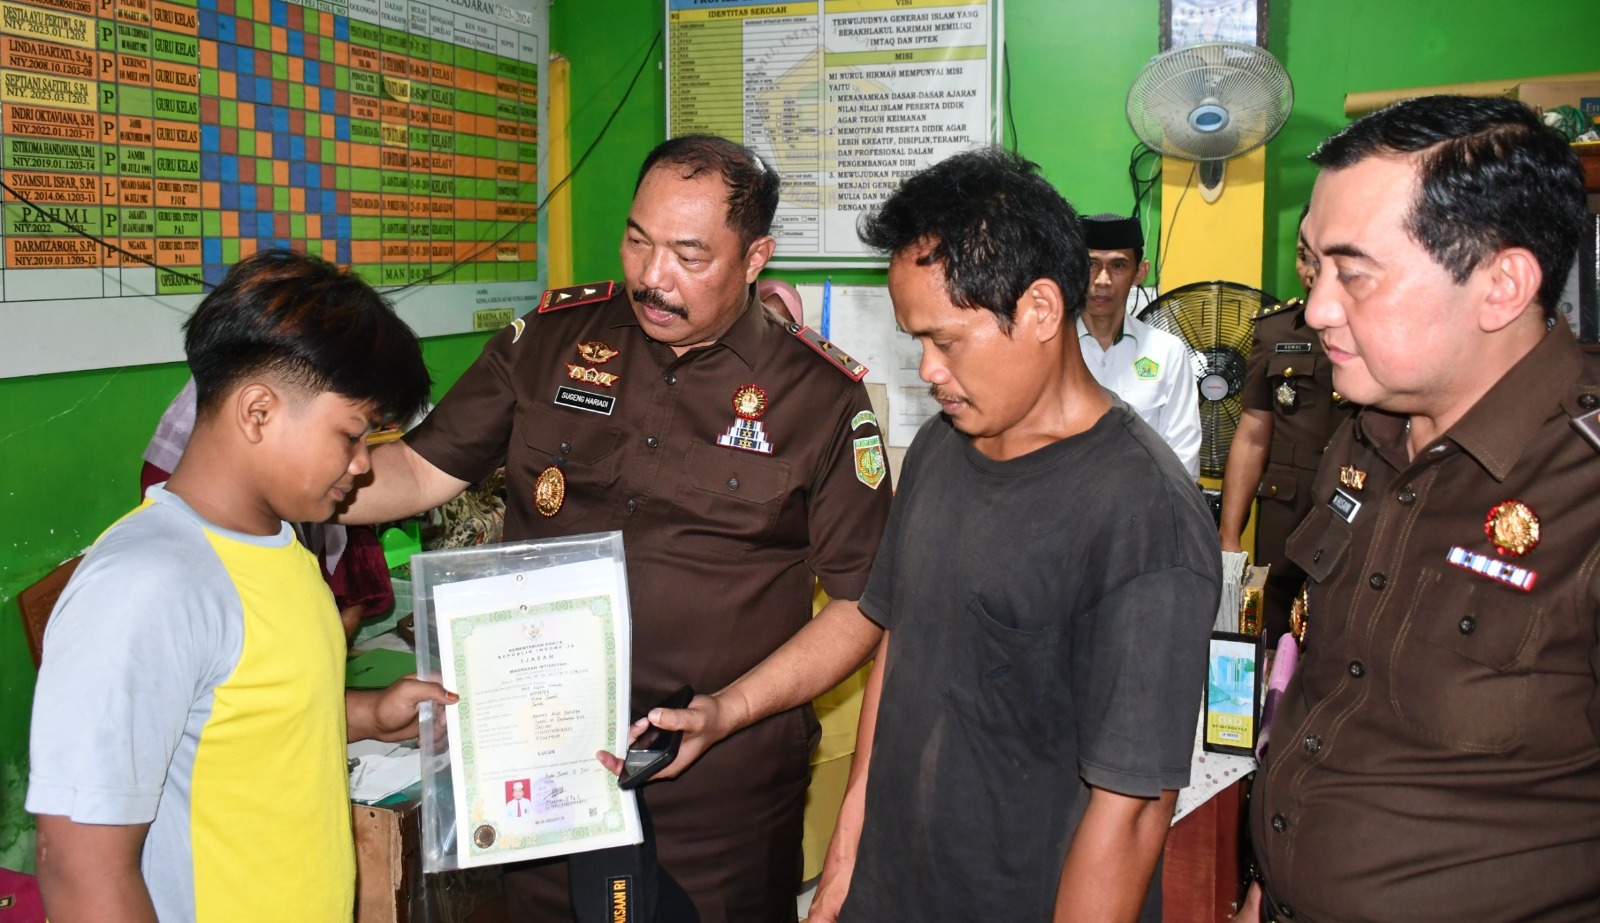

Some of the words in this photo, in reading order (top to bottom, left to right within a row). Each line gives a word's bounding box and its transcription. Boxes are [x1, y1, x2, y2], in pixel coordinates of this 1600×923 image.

[320, 3, 331, 11] TGL
[708, 8, 748, 18] IDENTITAS
[751, 7, 786, 15] SEKOLAH
[3, 6, 28, 21] DESTIA
[30, 11, 43, 25] AYU
[154, 8, 173, 24] GURU
[175, 12, 195, 28] KELAS
[833, 16, 888, 26] TERWUJUDNYA
[890, 14, 929, 22] GENERASI
[931, 12, 955, 21] ISLAM
[957, 10, 978, 19] YANG
[4, 19, 25, 30] NIY.
[28, 23, 88, 42] 2023.01.1203.
[102, 27, 112, 41] P
[839, 27, 893, 37] BERAKHLAKUL
[896, 25, 932, 34] KARIMAH
[935, 23, 972, 32] MEMILIKI
[870, 38, 895, 46] IMTAQ
[915, 35, 938, 43] IPTEK
[9, 39, 37, 53] LINDA
[38, 44, 75, 62] HARTATI,
[76, 51, 93, 66] S.Ag
[155, 38, 173, 53] GURU
[175, 42, 196, 57] KELAS
[10, 57, 92, 77] NIY.2008.10.1203-08
[102, 59, 113, 73] P
[122, 57, 147, 69] KERINCI
[126, 71, 137, 81] MEI
[155, 69, 174, 83] GURU
[176, 72, 196, 87] KELAS
[432, 68, 449, 81] KELAS
[840, 72, 864, 80] NURUL
[898, 68, 943, 77] MEMPUNYAI
[946, 67, 963, 75] MISI
[5, 74, 41, 90] SEPTIANI
[74, 83, 88, 96] S.Pd
[6, 87, 27, 97] NIY.
[30, 91, 89, 105] 2023.03.1203.
[103, 90, 114, 104] P
[432, 89, 449, 104] KELAS
[838, 93, 889, 102] MENANAMKAN
[891, 91, 944, 99] DASAR-DASAR
[946, 90, 976, 98] AJARAN
[156, 97, 175, 112] GURU
[176, 100, 197, 115] KELAS
[838, 105, 879, 113] NILAI-NILAI
[881, 104, 903, 112] ISLAM
[942, 101, 964, 109] DIDIK
[11, 107, 33, 120] INDRI
[35, 111, 79, 126] OKTAVIANA,
[81, 115, 94, 126] S.Pd
[432, 113, 449, 125] KELAS
[838, 116, 857, 124] AGAR
[860, 115, 884, 123] TEGUH
[887, 114, 927, 122] KEIMANAN
[12, 124, 94, 139] NIY.2022.01.1203-17
[104, 121, 114, 135] P
[838, 126, 883, 135] MEMOTIFASI
[946, 124, 967, 132] AGAR
[157, 127, 175, 141] GURU
[177, 130, 197, 143] KELAS
[837, 137, 859, 146] LEBIH
[862, 137, 897, 146] KREATIF,
[12, 141, 42, 153] ISTIKOMA
[837, 149, 852, 157] DAN
[854, 148, 905, 156] PROFESIONAL
[907, 147, 934, 155] DALAM
[13, 157, 95, 170] NIY.2019.01.1203-14
[105, 152, 115, 166] P
[157, 158, 176, 171] GURU
[177, 159, 198, 173] KELAS
[432, 158, 448, 169] KELAS
[837, 159, 897, 168] PENGEMBANGAN
[12, 174, 52, 187] SYAMSUL
[54, 177, 78, 190] ISFAR,
[80, 178, 95, 190] S.Pd
[157, 182, 171, 192] GURU
[183, 184, 198, 193] STUDY
[432, 180, 448, 193] KELAS
[105, 183, 115, 197] L
[34, 192, 95, 202] 2014.06.1203-11
[106, 213, 117, 227] P
[158, 212, 172, 221] GURU
[183, 212, 198, 222] STUDY
[14, 240, 78, 253] DARMIZAROH,
[80, 241, 96, 252] S.Pd
[159, 241, 173, 250] GURU
[184, 242, 199, 250] STUDY
[15, 256, 97, 266] NIY.2019.01.1203-12
[386, 269, 405, 280] MAN
[562, 392, 585, 403] SUGENG
[585, 397, 608, 408] HARIADI
[614, 879, 626, 890] RI
